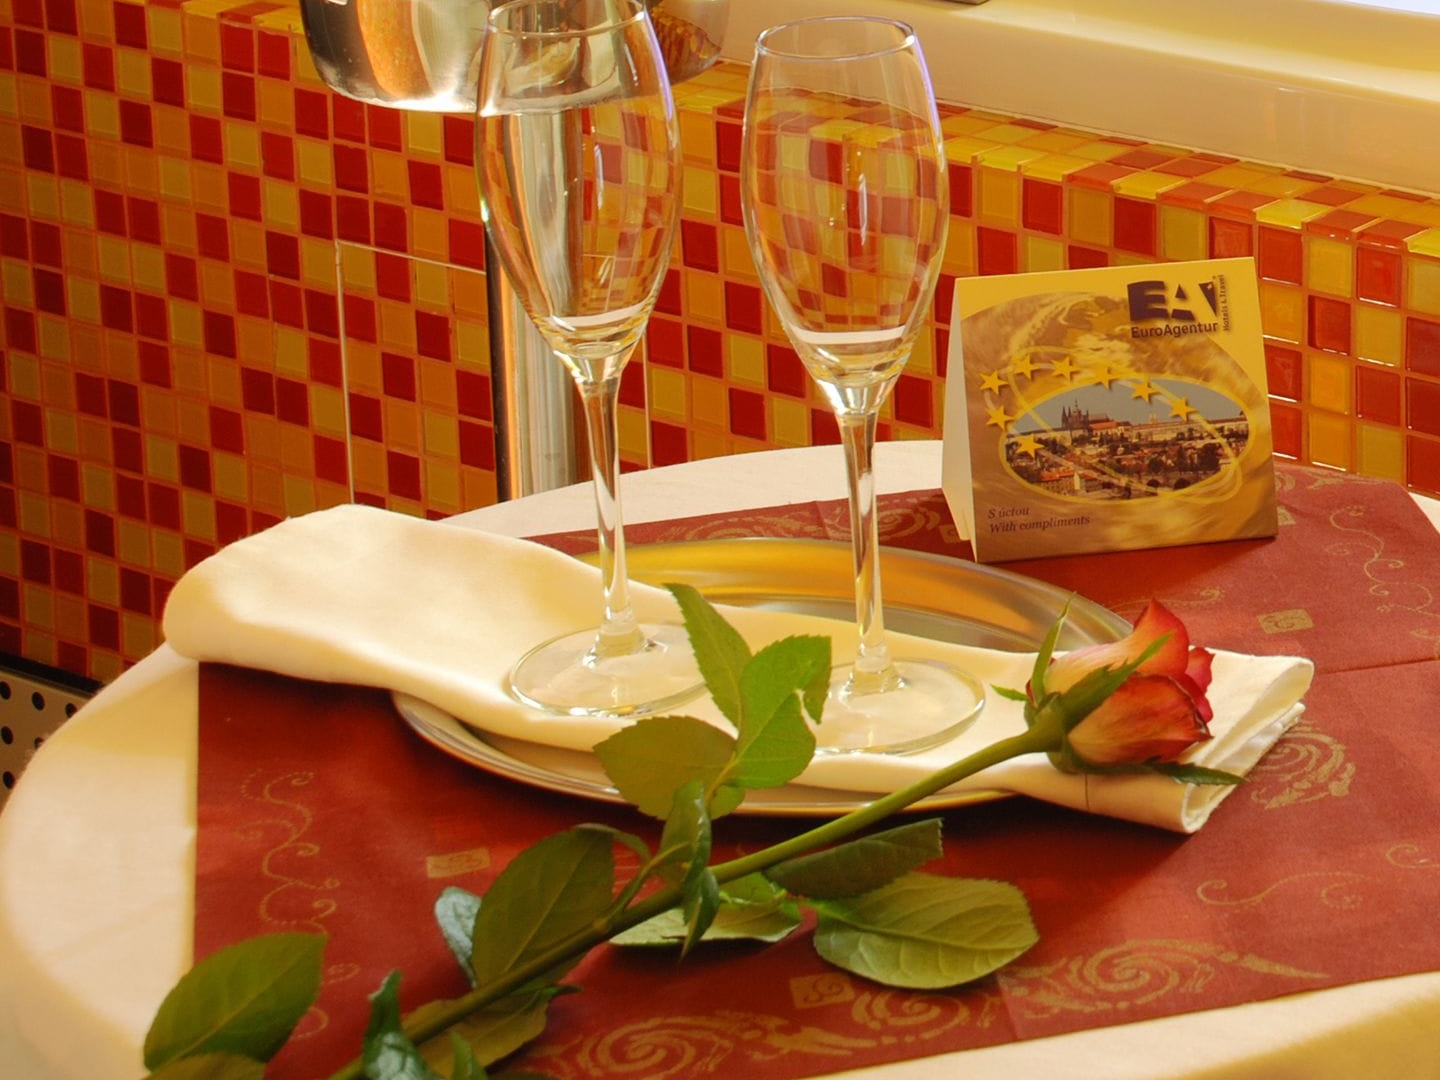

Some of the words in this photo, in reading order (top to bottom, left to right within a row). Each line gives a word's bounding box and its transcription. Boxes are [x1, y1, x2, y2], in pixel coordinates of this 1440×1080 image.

[1217, 274, 1227, 298] Travel
[1221, 306, 1231, 331] Hotels
[1131, 322, 1219, 338] EuroAgentur
[987, 508, 997, 520] S
[990, 521, 1017, 533] With
[1019, 516, 1091, 531] compliments
